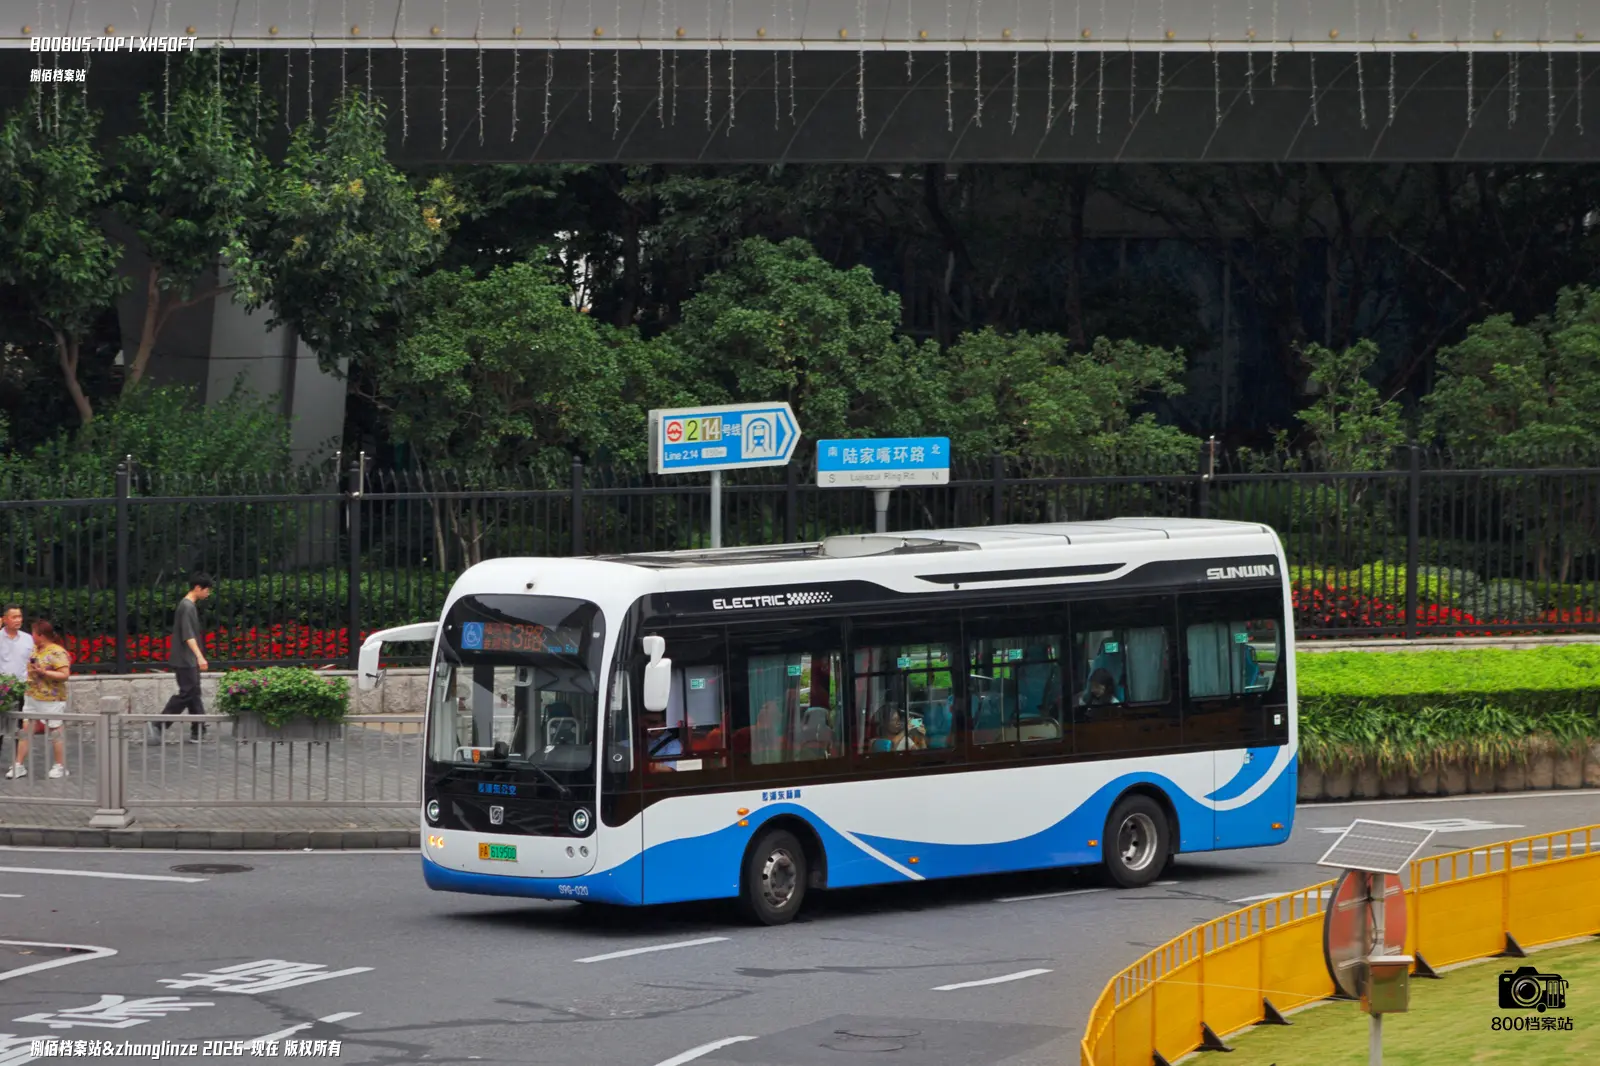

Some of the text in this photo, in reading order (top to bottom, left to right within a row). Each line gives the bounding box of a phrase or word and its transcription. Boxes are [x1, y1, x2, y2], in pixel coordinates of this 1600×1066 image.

[687, 419, 742, 441] 2 14 号线
[664, 451, 682, 461] Line
[828, 443, 941, 465] 南 陆家嘴环路 北
[828, 473, 837, 484] S
[931, 471, 940, 481] N
[1206, 564, 1275, 580] SUNWIN
[712, 594, 785, 610] ELECTRIC
